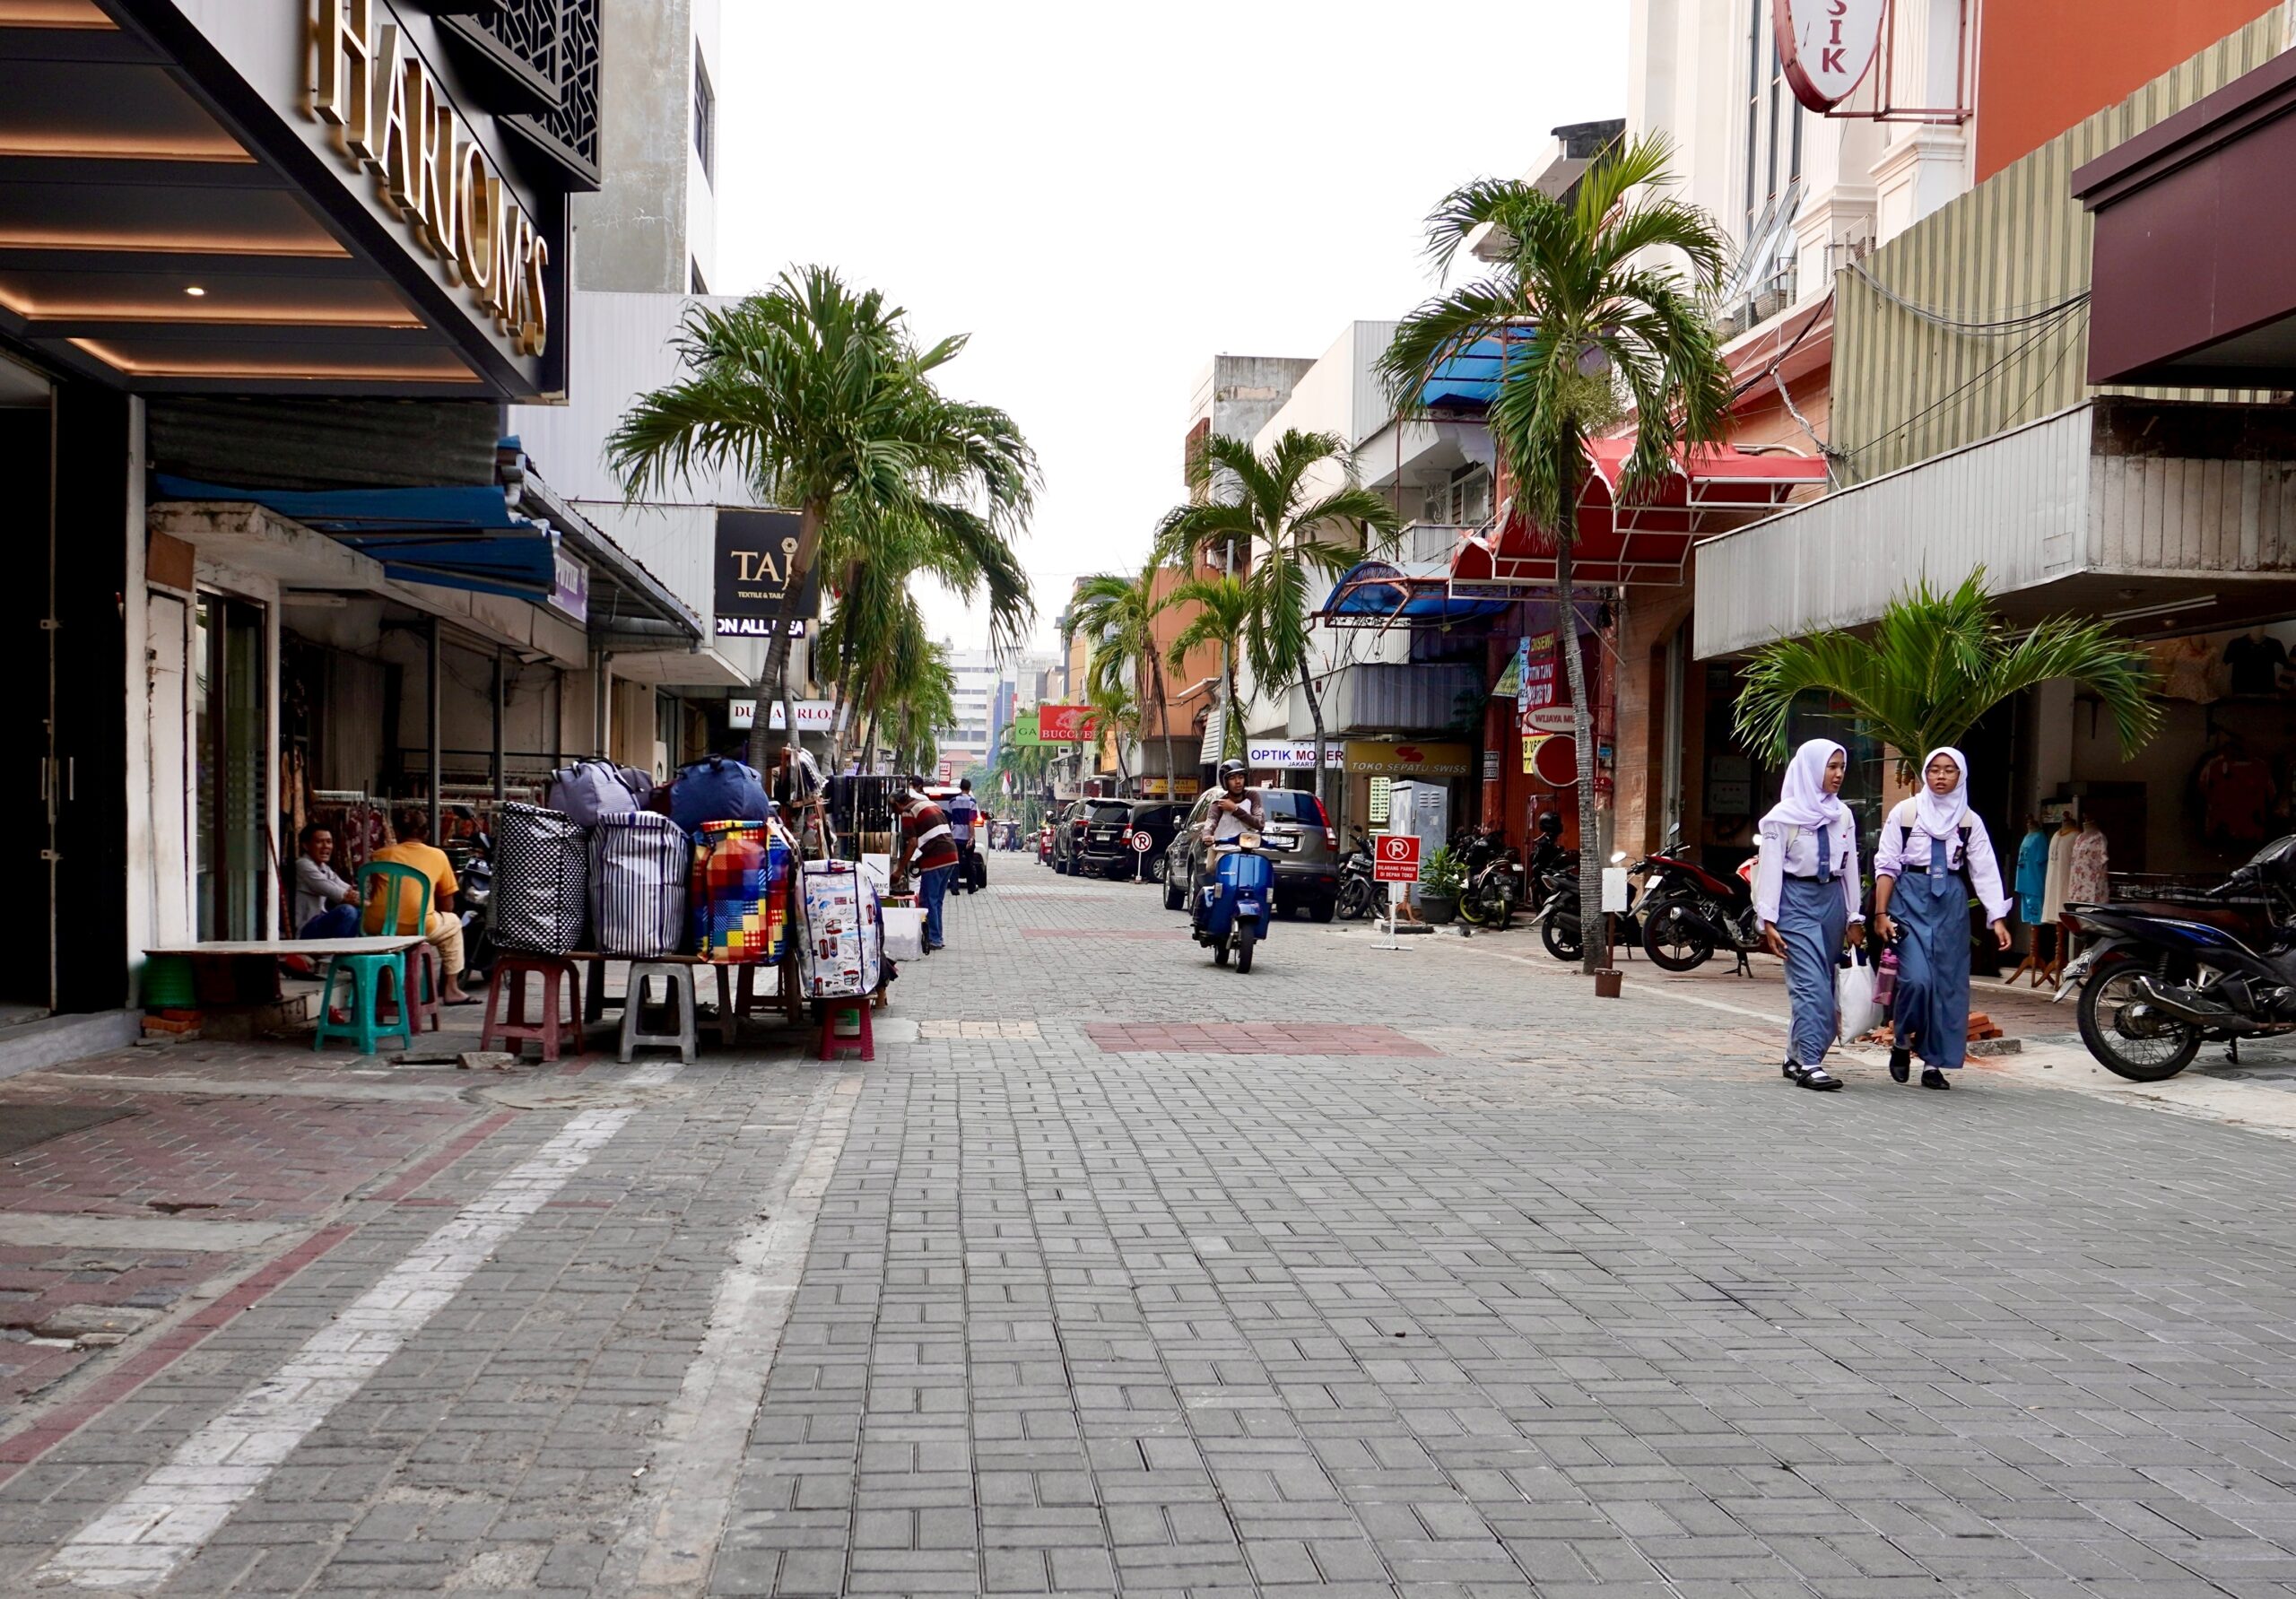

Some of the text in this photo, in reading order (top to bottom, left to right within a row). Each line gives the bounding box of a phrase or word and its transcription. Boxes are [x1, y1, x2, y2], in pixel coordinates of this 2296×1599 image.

[740, 618, 770, 634] ALL
[1251, 750, 1344, 761] OPTIK MOER
[1352, 761, 1467, 773] TOKO SEPATU SWISS
